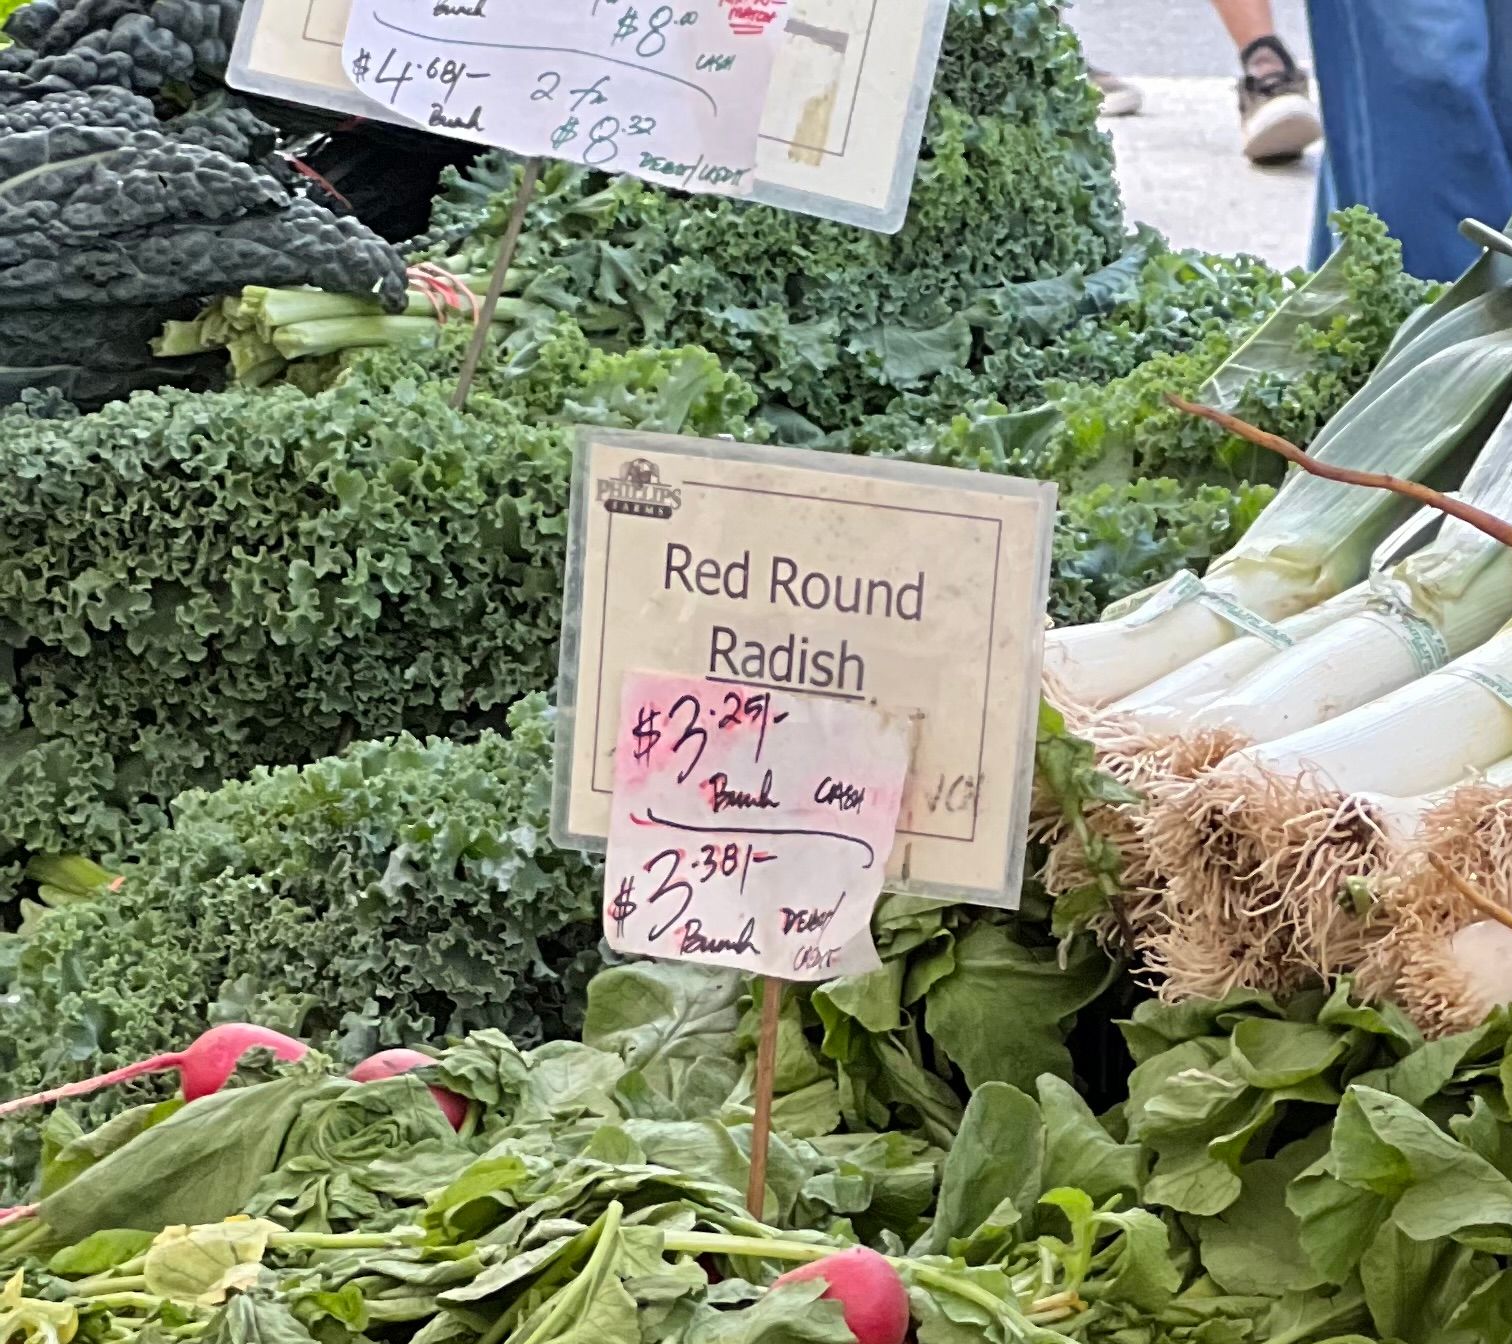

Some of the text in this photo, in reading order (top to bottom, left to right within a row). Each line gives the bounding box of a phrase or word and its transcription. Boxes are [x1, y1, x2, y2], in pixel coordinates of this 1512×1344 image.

[595, 478, 682, 510] PHILLIPS
[612, 501, 665, 516] FARMS
[664, 542, 926, 623] Red Round
[708, 625, 866, 692] Radish
